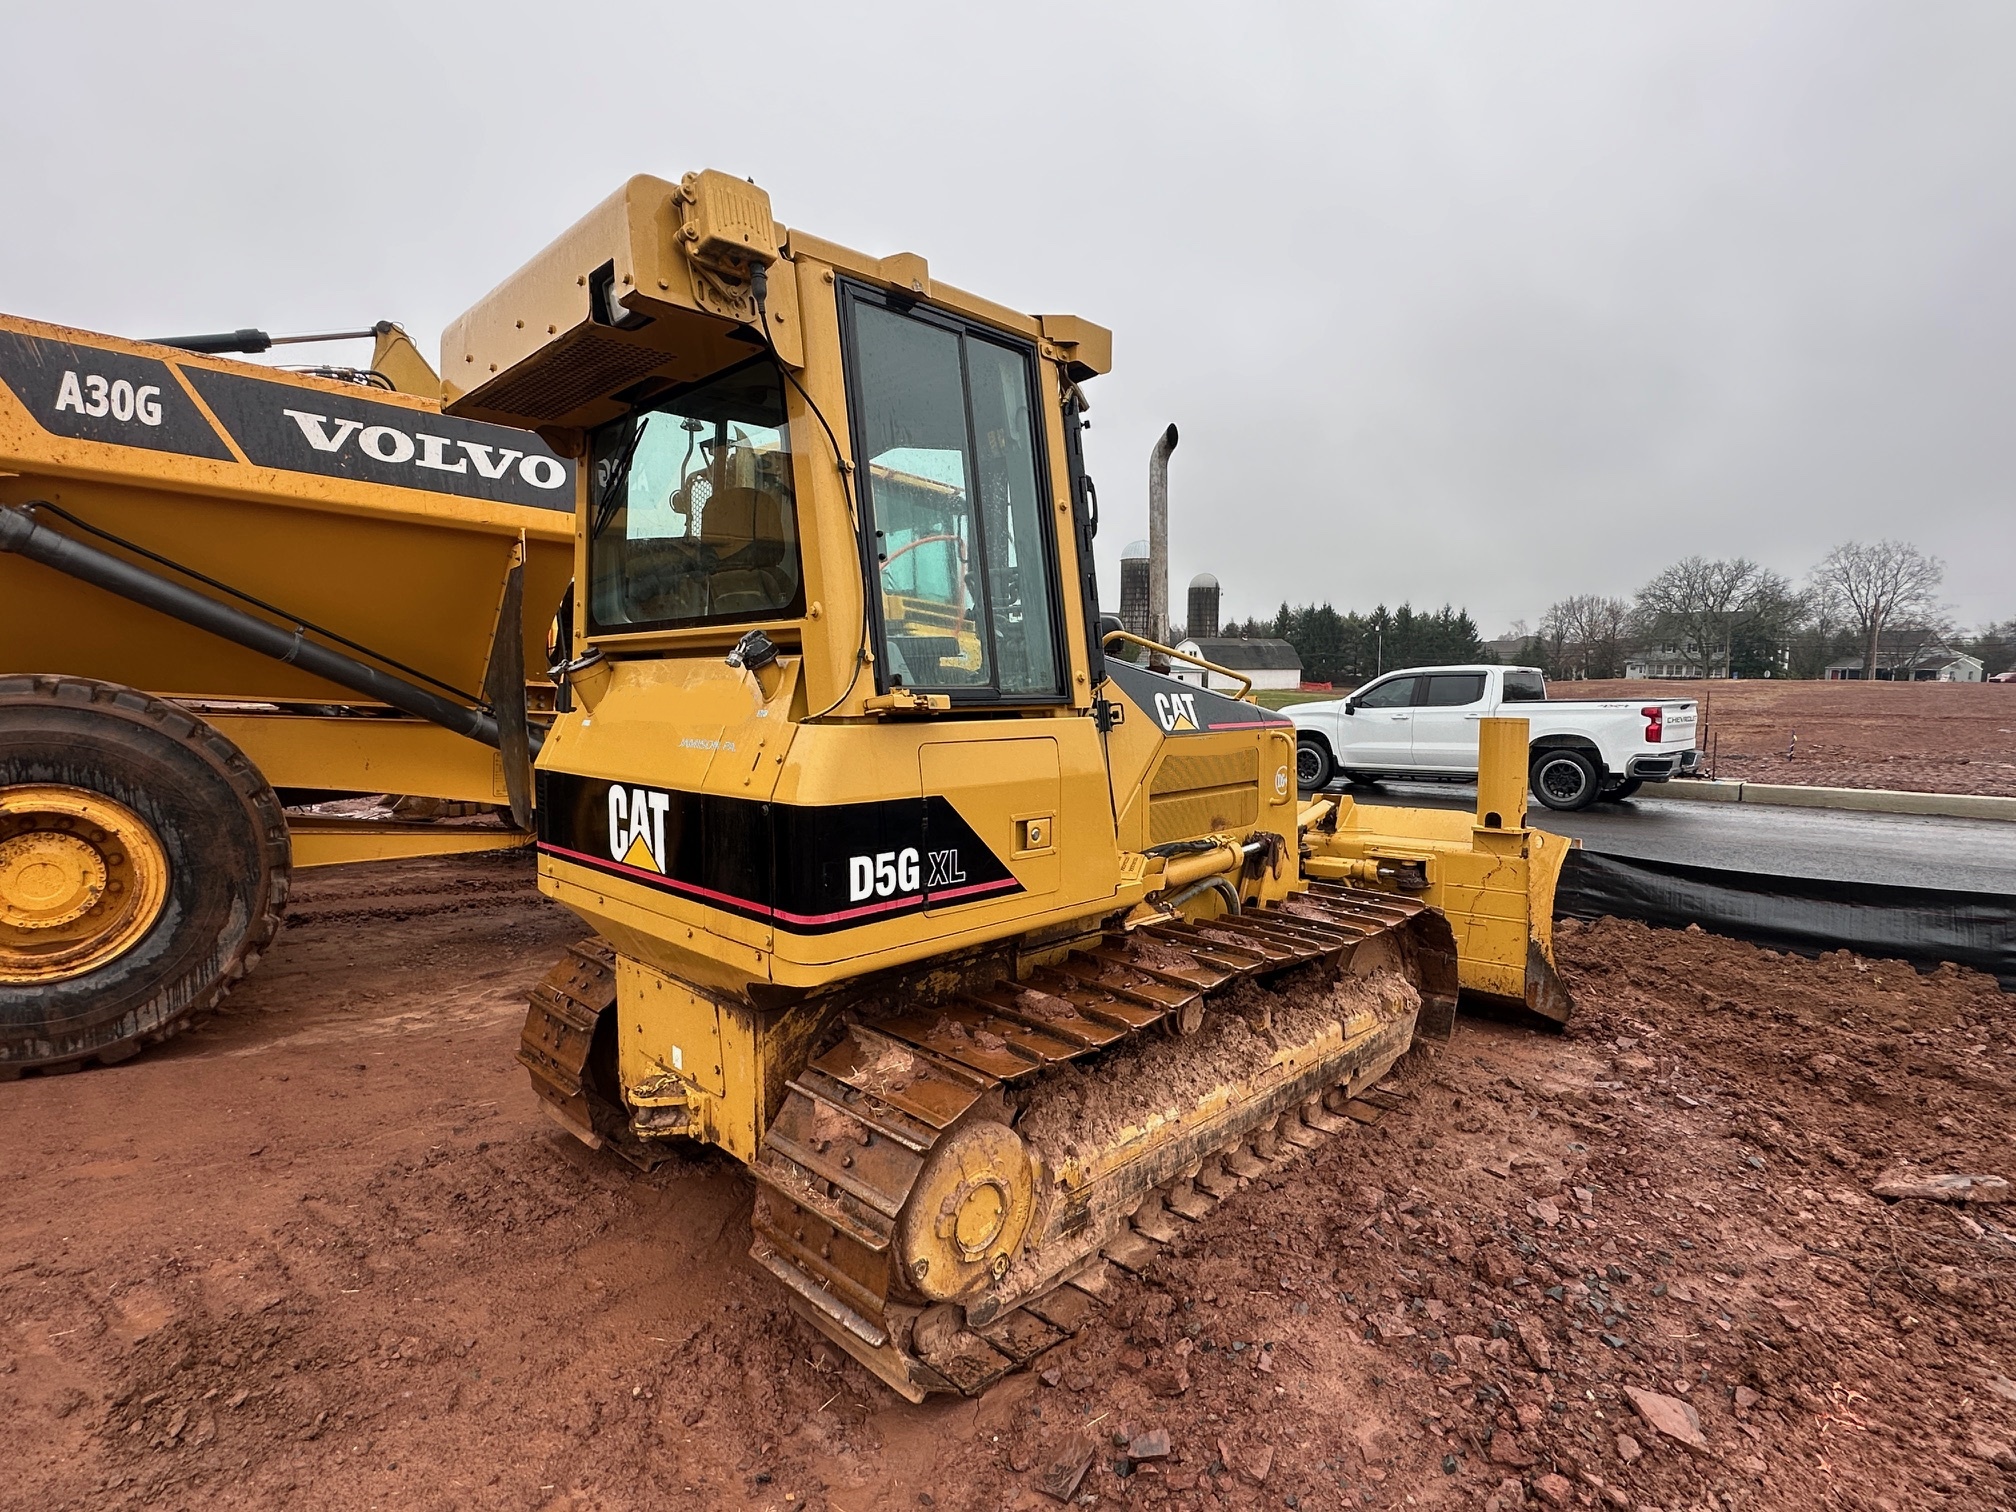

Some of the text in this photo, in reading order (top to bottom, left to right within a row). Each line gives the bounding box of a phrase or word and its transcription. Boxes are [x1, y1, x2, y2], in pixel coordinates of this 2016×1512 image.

[55, 370, 162, 426] A30G
[283, 408, 567, 489] VOLVO
[1154, 692, 1200, 731] CAT
[608, 784, 669, 875] CAT
[849, 847, 966, 902] D5G XL
